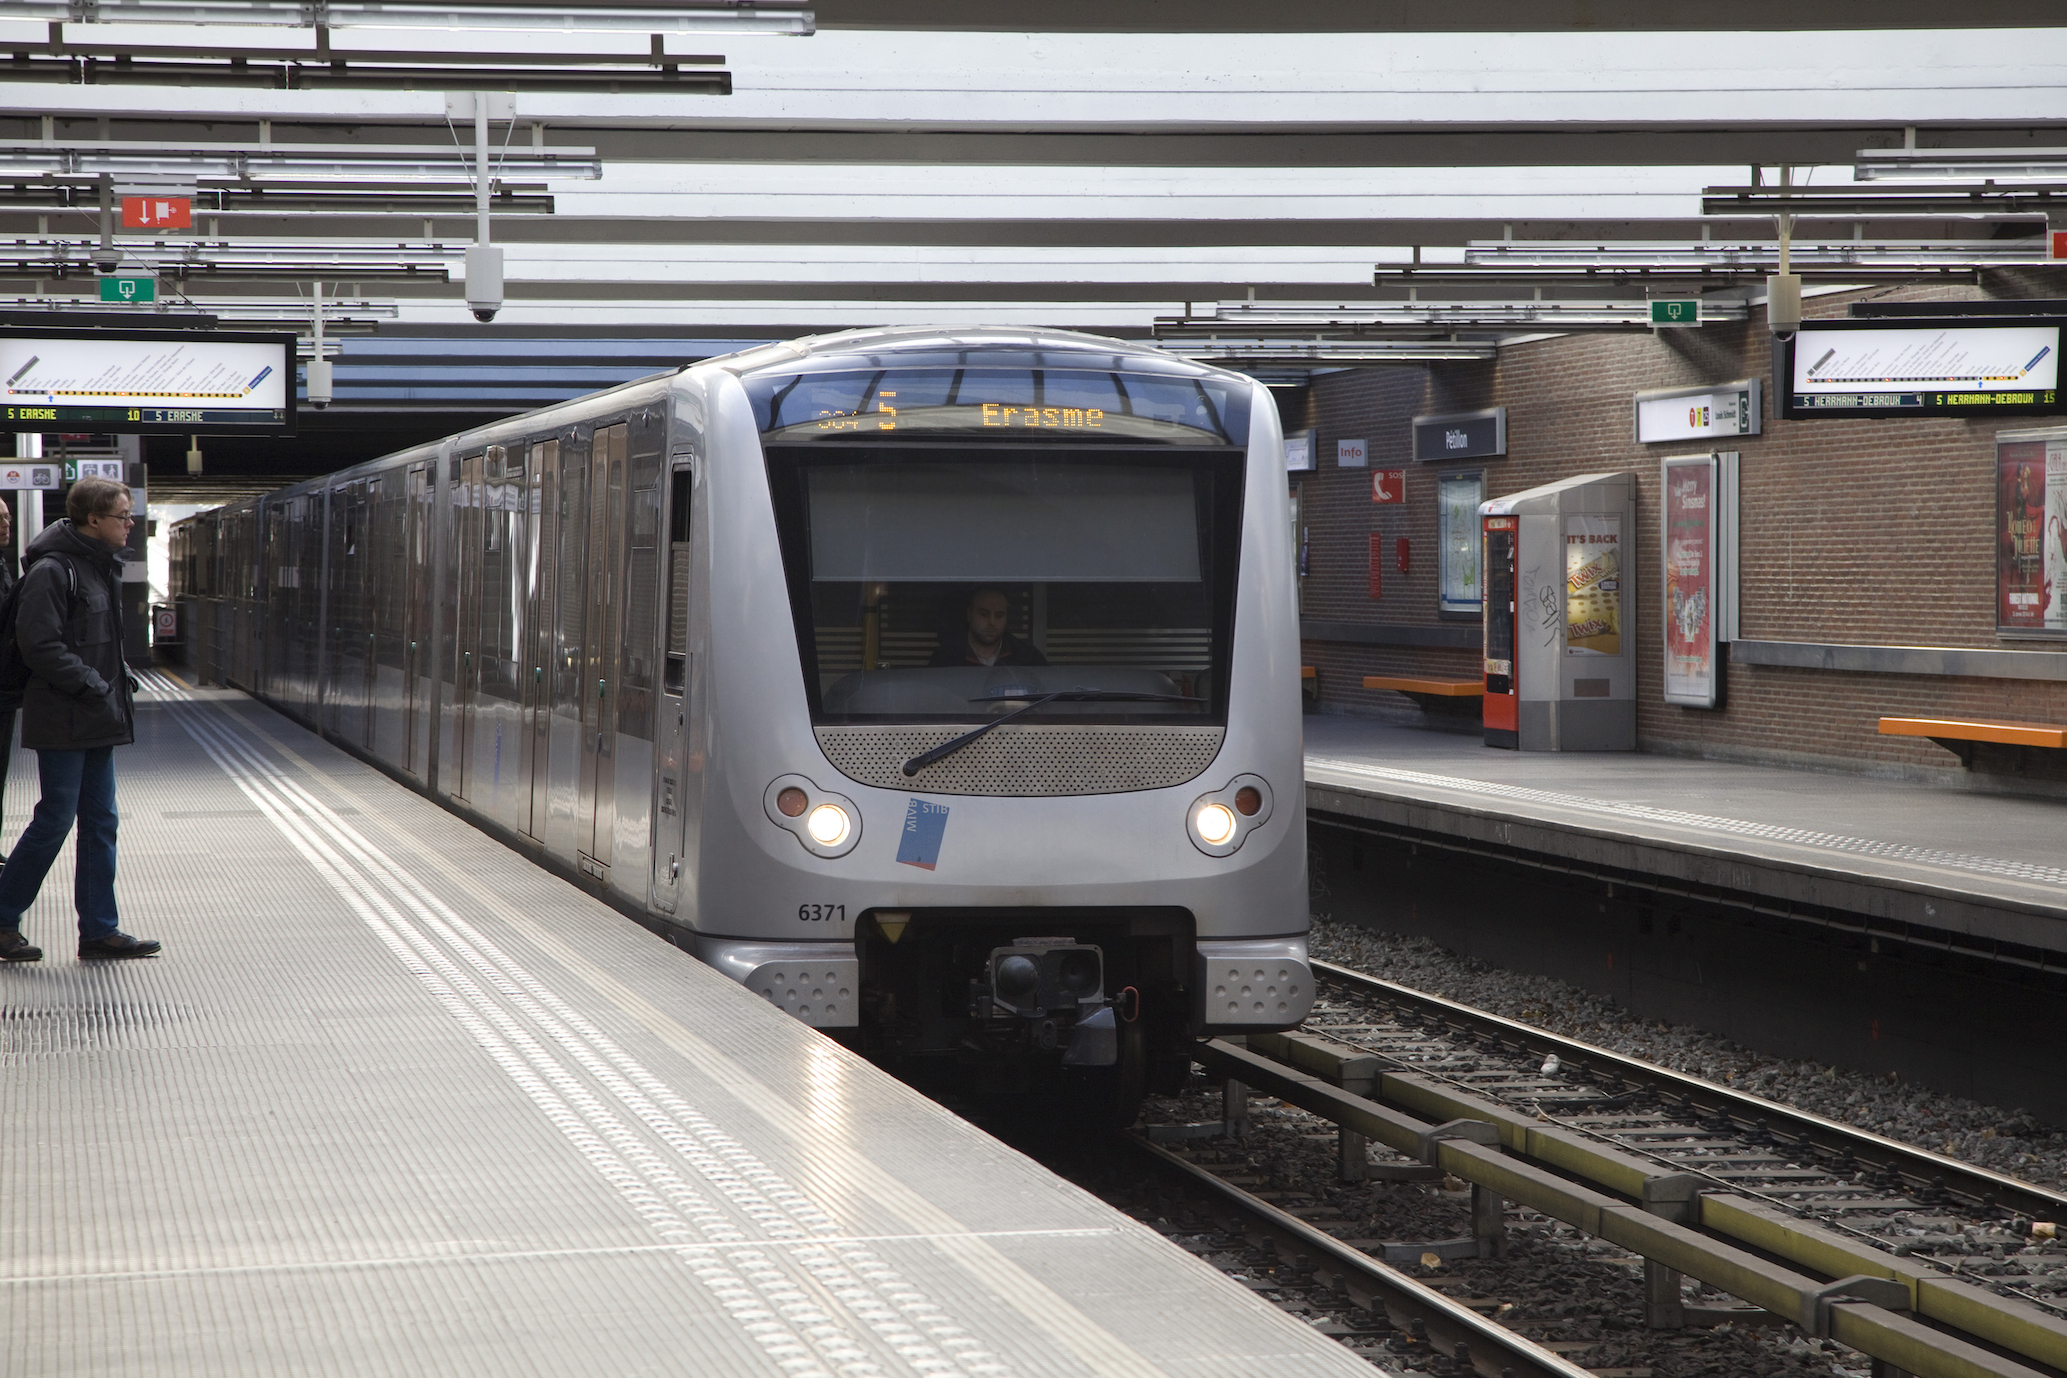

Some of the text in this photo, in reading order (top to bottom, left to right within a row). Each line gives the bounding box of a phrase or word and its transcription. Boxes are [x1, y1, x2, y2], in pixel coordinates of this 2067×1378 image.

[1803, 395, 1922, 407] 5 HERRMANN-DEBROUX 4
[1936, 392, 2055, 406] 5 HERRMANN-DEBROUX 15
[7, 408, 140, 421] 5 ERASME 10
[155, 410, 203, 422] 5 ERASME
[878, 391, 897, 430] 5
[982, 403, 1103, 427] Erasme
[1340, 447, 1362, 459] Info
[1567, 534, 1618, 544] IT'S BACK
[922, 803, 948, 815] STIB
[907, 800, 918, 832] MIVB
[798, 904, 846, 922] 6371
